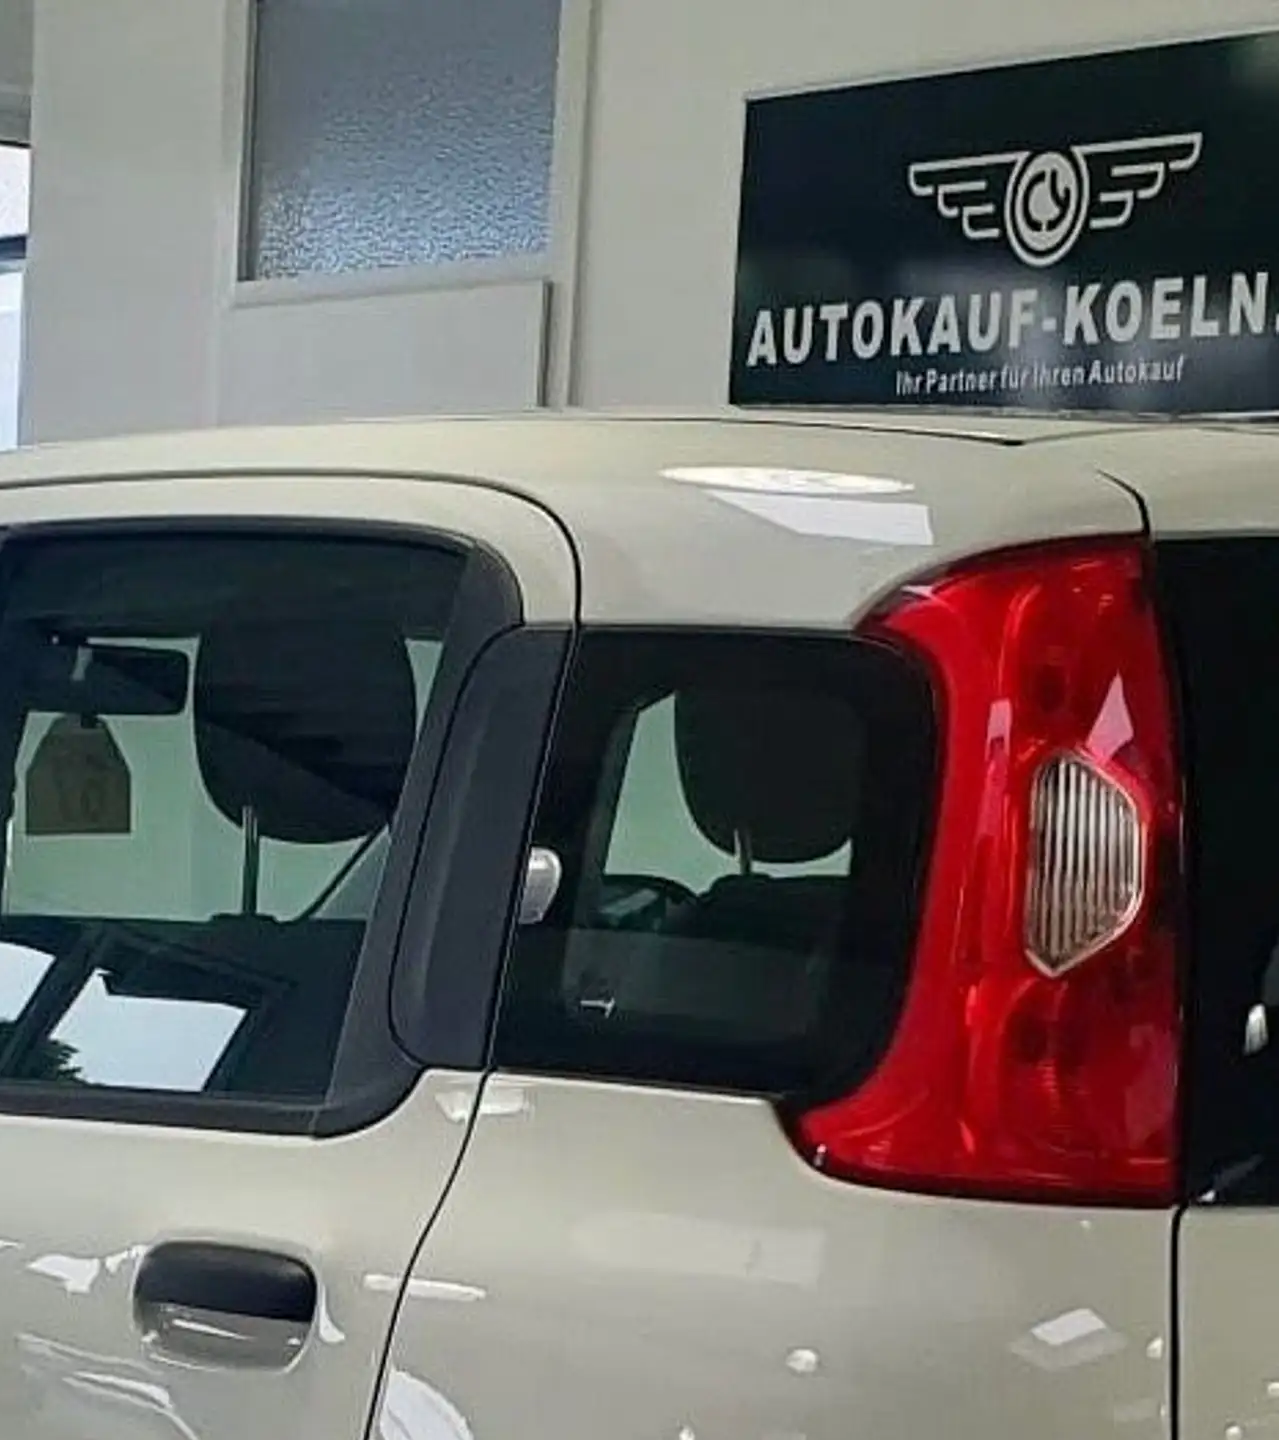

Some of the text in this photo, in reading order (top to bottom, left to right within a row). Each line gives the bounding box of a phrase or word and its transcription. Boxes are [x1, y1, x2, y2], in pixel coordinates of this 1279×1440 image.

[895, 369, 922, 396] Ihr
[925, 367, 997, 394] Partner
[1031, 357, 1085, 392] Ihren
[1087, 352, 1185, 386] Autokauf
